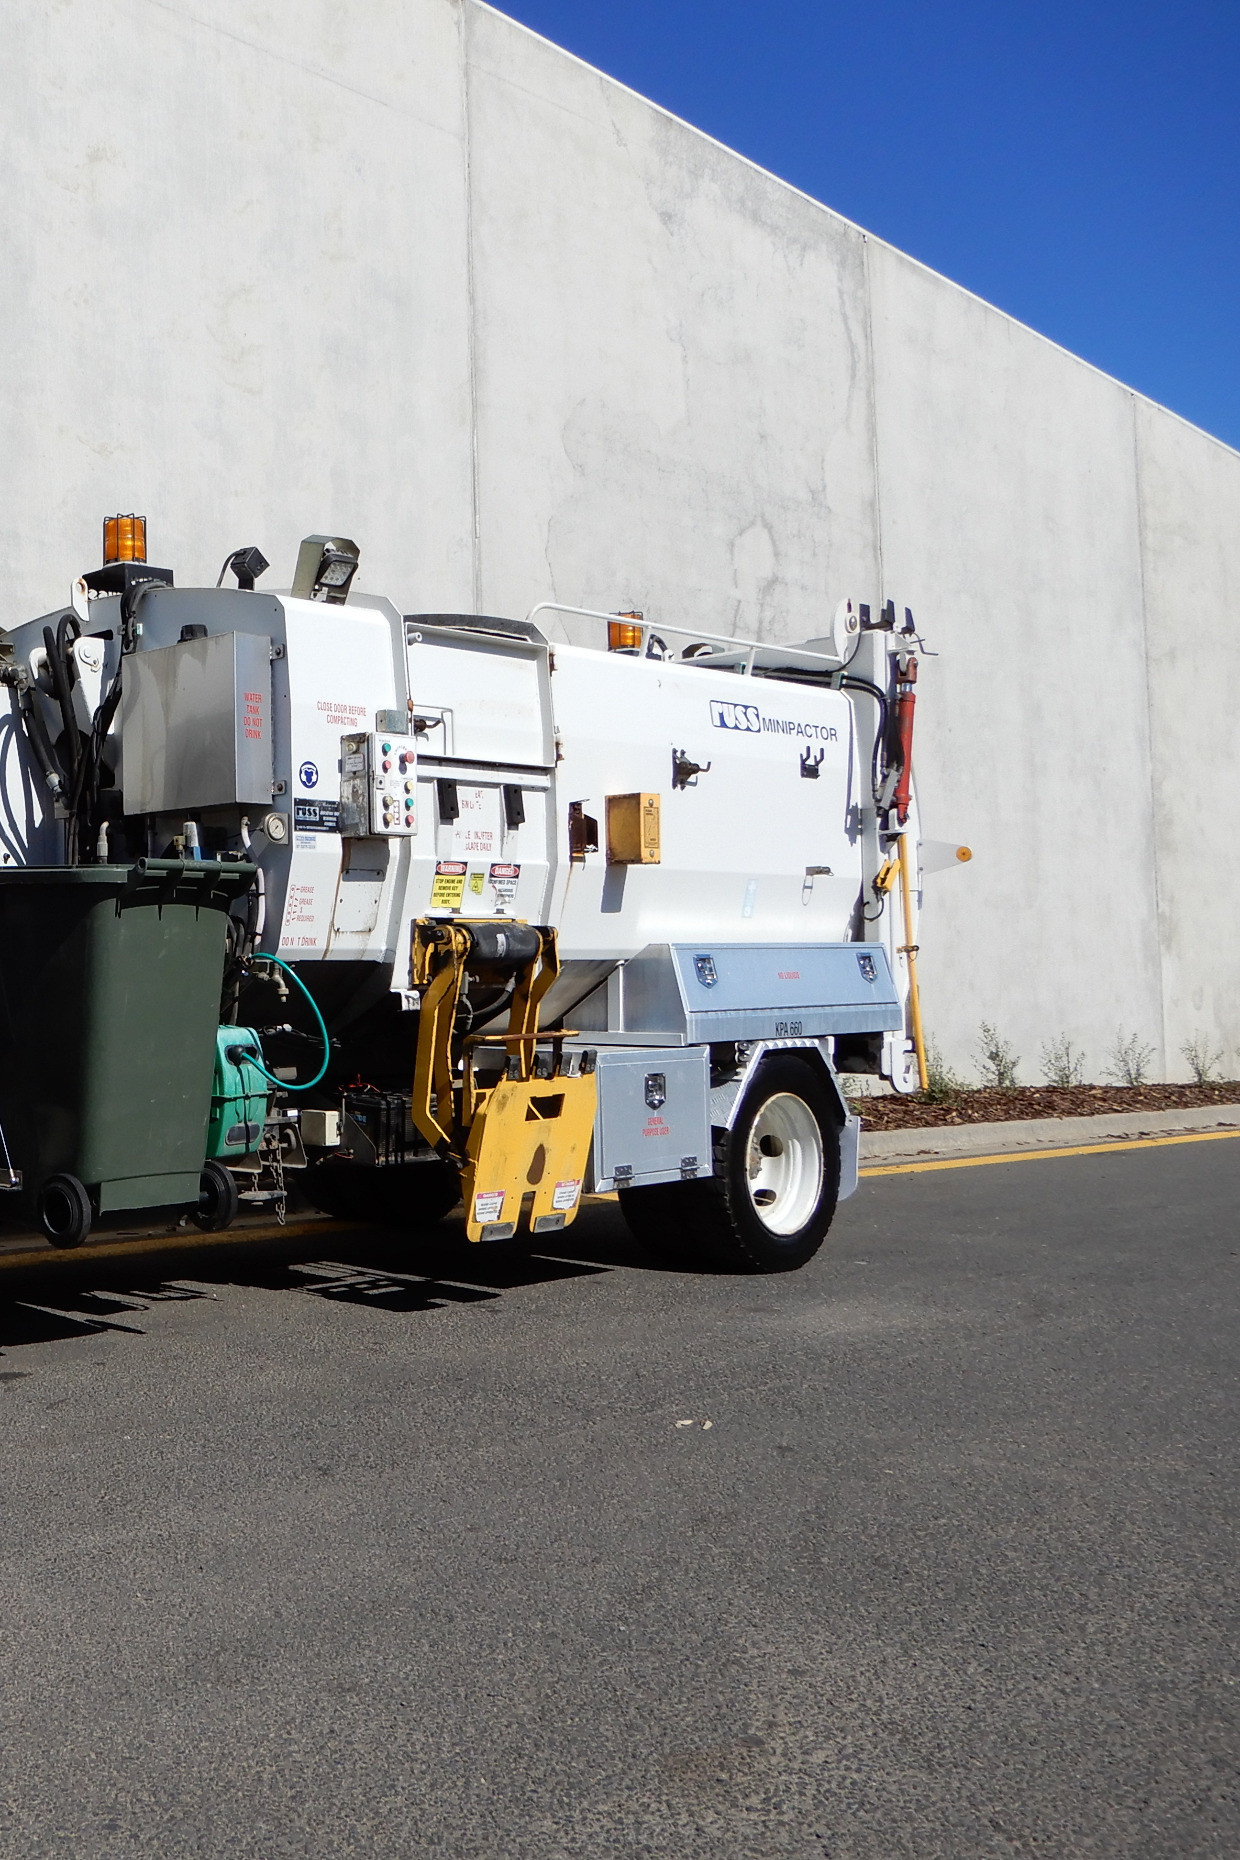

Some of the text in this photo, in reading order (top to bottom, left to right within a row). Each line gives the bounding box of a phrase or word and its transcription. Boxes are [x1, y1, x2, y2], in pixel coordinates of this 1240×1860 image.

[244, 692, 262, 703] WATER
[246, 704, 260, 715] TANK
[317, 700, 367, 717] CLOSE DOOR BEFORE
[244, 716, 263, 728] DO NOT
[326, 714, 358, 727] COMPACTING
[245, 728, 262, 740] DRINK
[762, 717, 838, 742] MINIPACTOR
[775, 1020, 802, 1036] KPA 660
